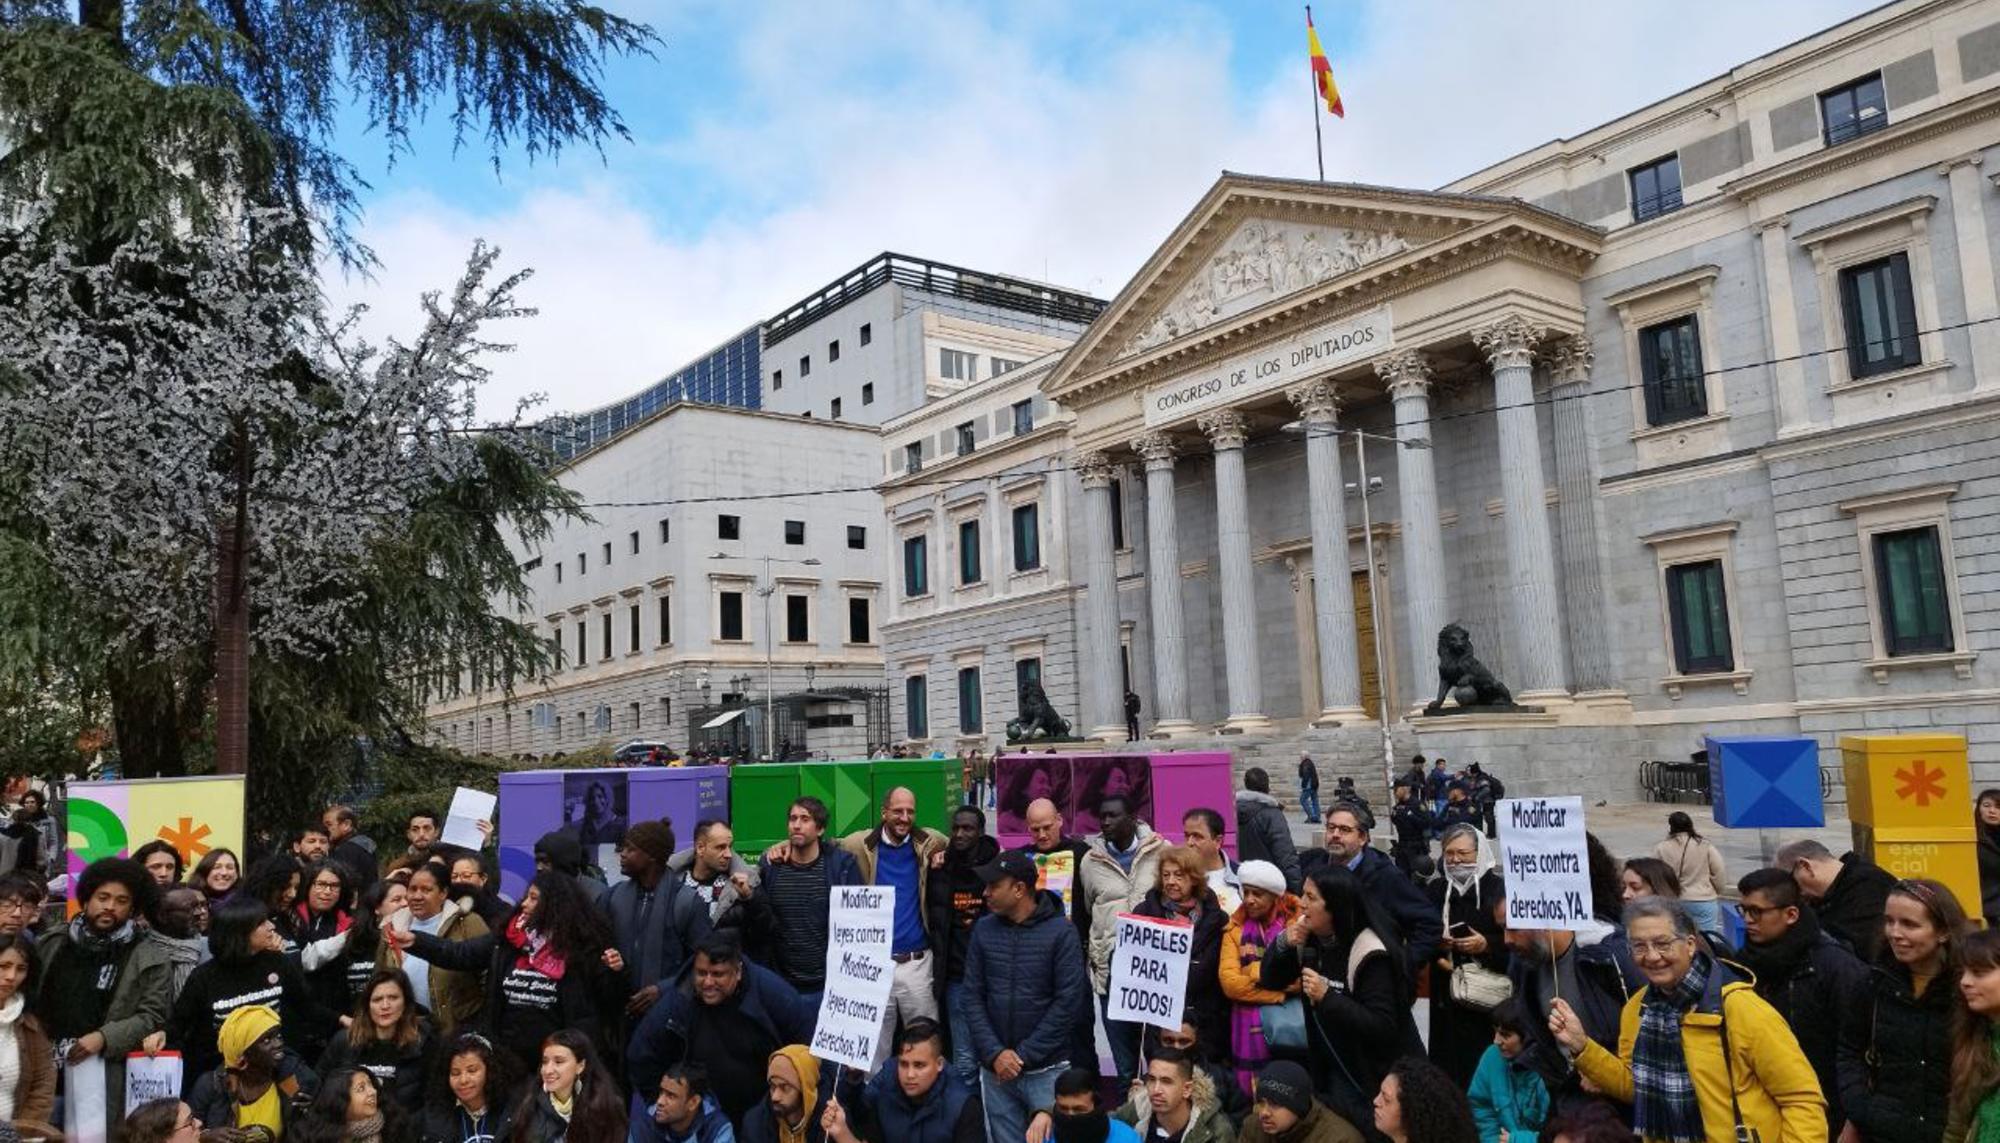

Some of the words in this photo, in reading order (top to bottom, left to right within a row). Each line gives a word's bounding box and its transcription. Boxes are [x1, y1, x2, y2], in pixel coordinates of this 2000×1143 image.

[1157, 378, 1222, 411] CONGRESO
[1230, 371, 1247, 387] DE
[1255, 358, 1281, 379] LOS
[1291, 326, 1375, 367] DIPUTADOS
[1511, 800, 1567, 828] Modificar
[1507, 846, 1537, 881] leyes
[1539, 850, 1580, 873] contra
[1888, 843, 1939, 857] esen
[1890, 856, 1929, 874] cial
[841, 887, 883, 909] Modificar
[833, 920, 856, 947] leyes
[856, 924, 886, 943] contra
[1119, 923, 1188, 954] ¡PAPELES
[840, 951, 882, 981] Modificar
[1130, 956, 1168, 984] PARA
[826, 989, 848, 1018] leyes
[848, 999, 878, 1022] contra
[1120, 986, 1173, 1017] TODOS!
